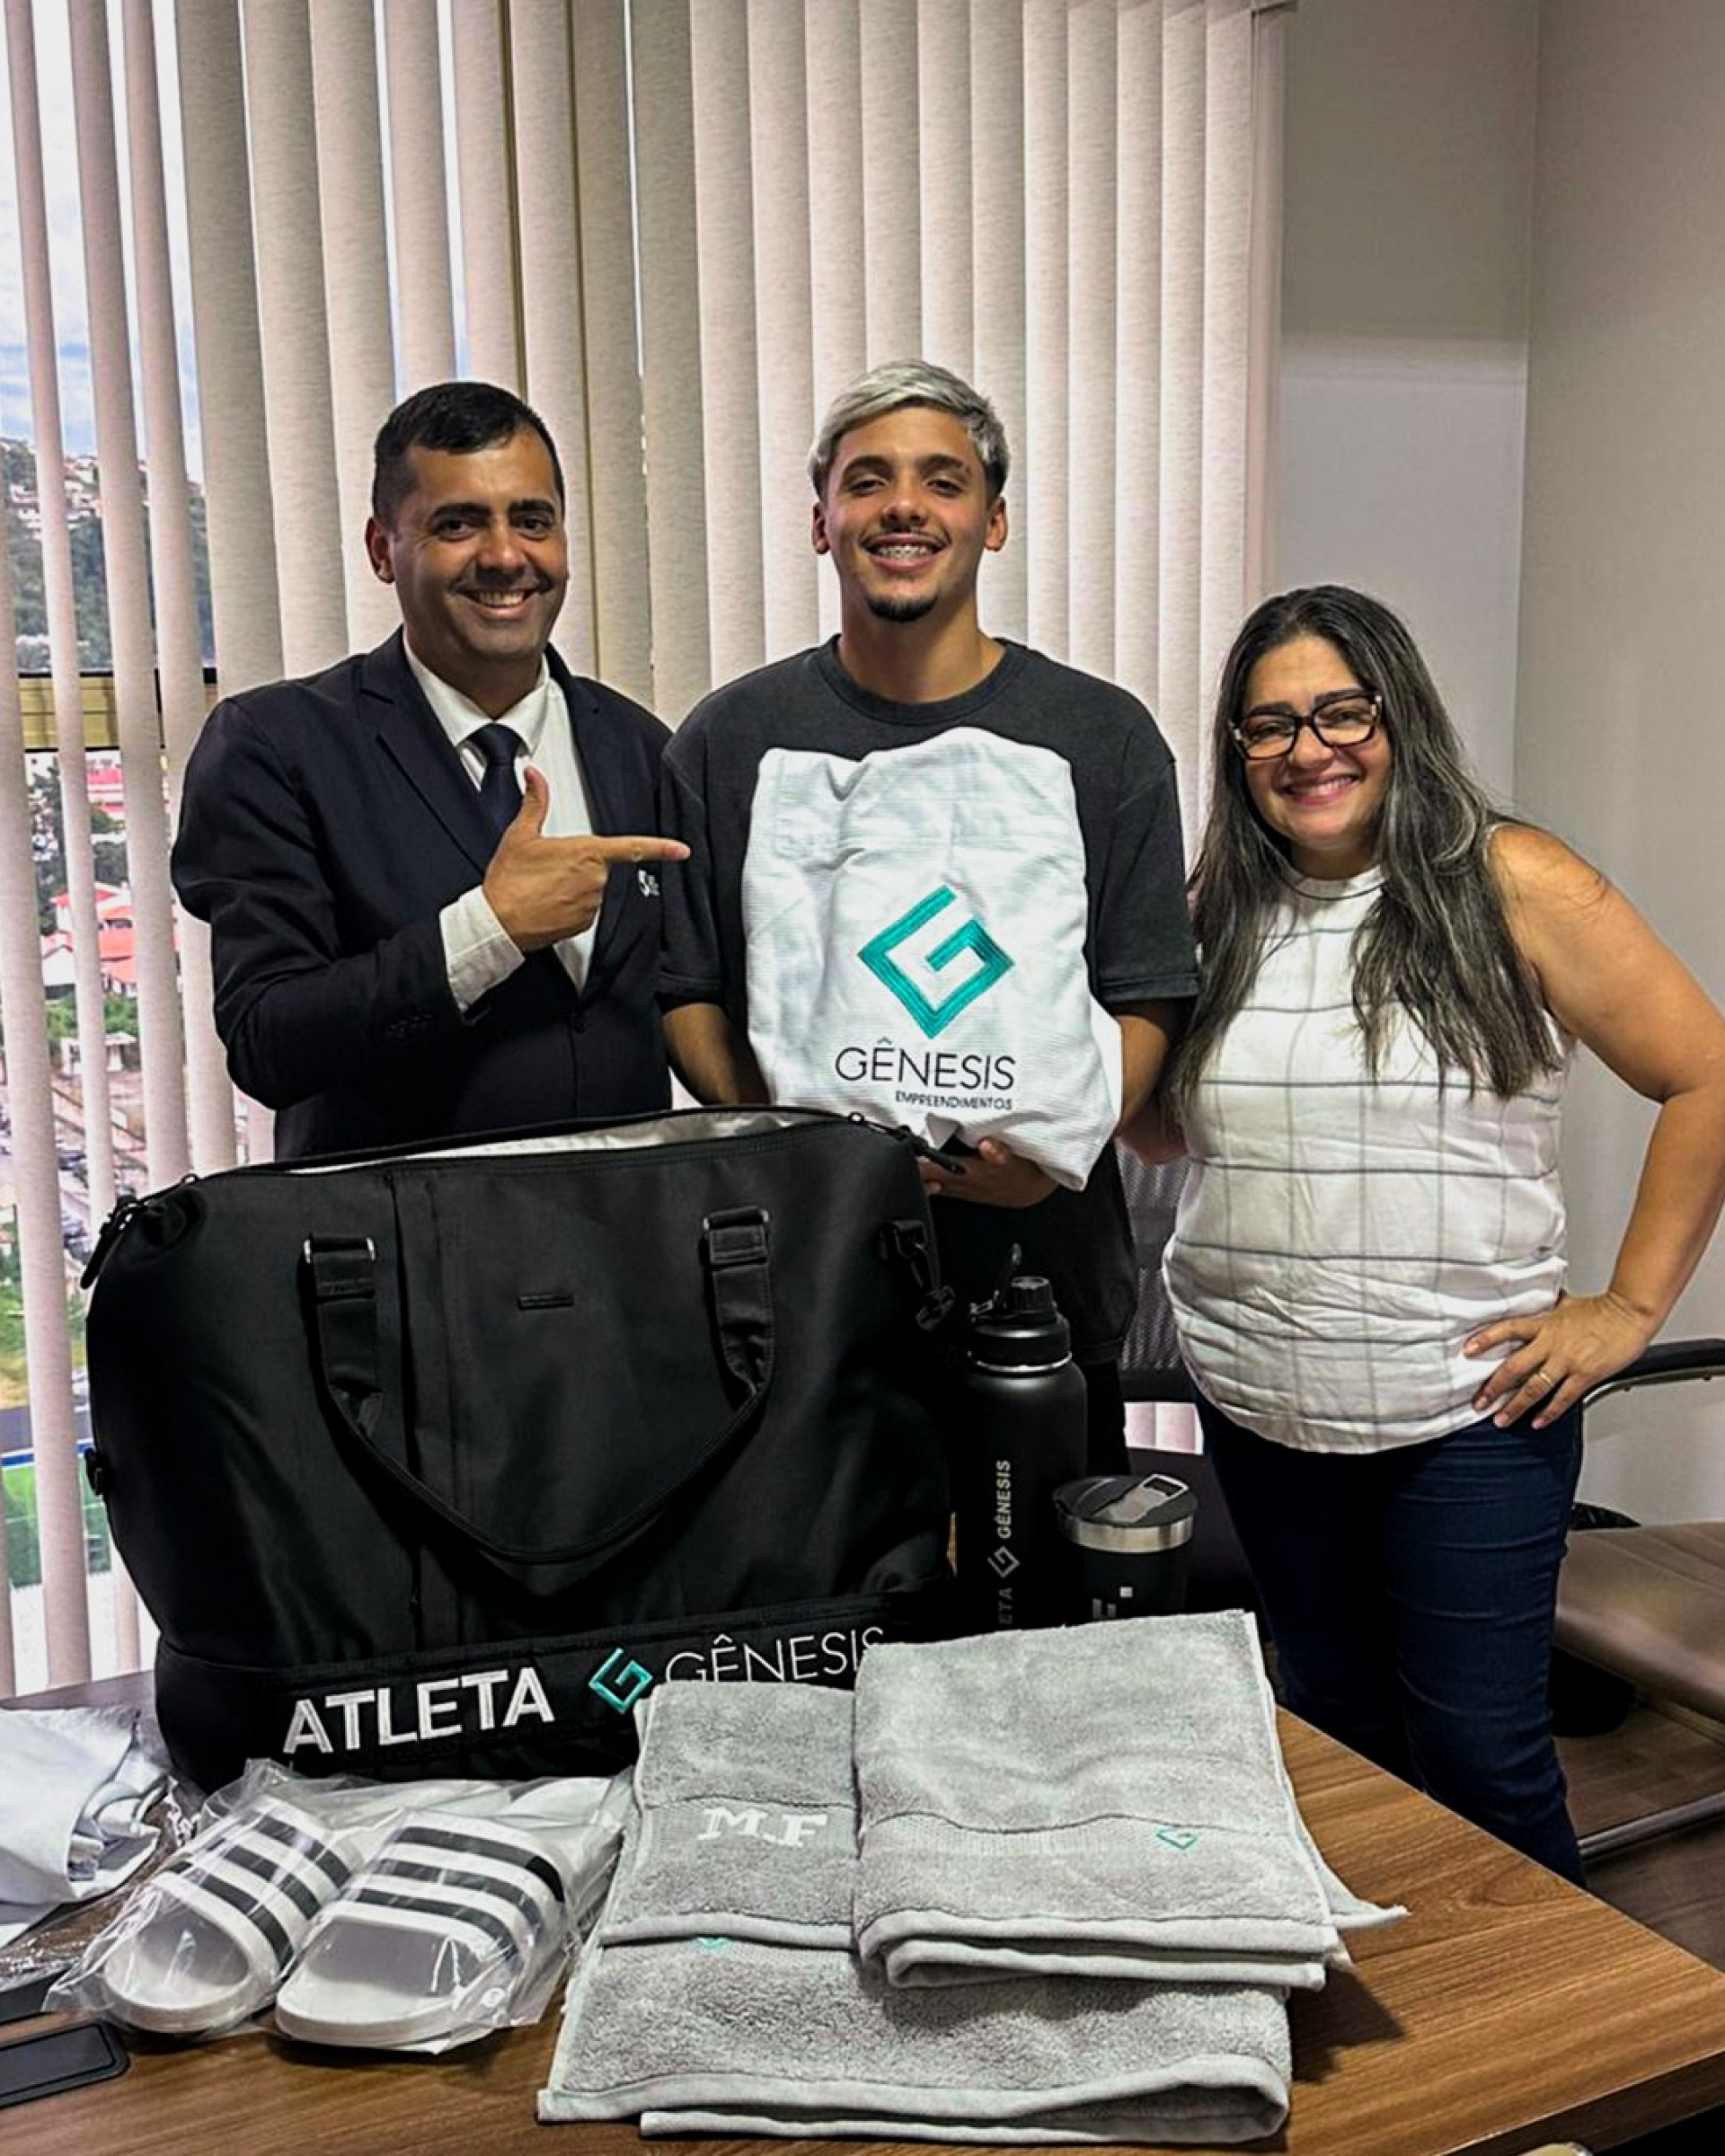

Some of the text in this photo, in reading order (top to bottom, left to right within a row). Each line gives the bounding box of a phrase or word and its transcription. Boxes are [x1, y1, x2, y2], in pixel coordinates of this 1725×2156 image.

[835, 1037, 1017, 1091] GÊNESIS
[895, 1090, 1013, 1110] EMPREENDIMENTOS
[993, 1459, 1013, 1540] GÊNESIS
[997, 1587, 1013, 1625] ETA
[282, 1666, 555, 1754] ATLETA
